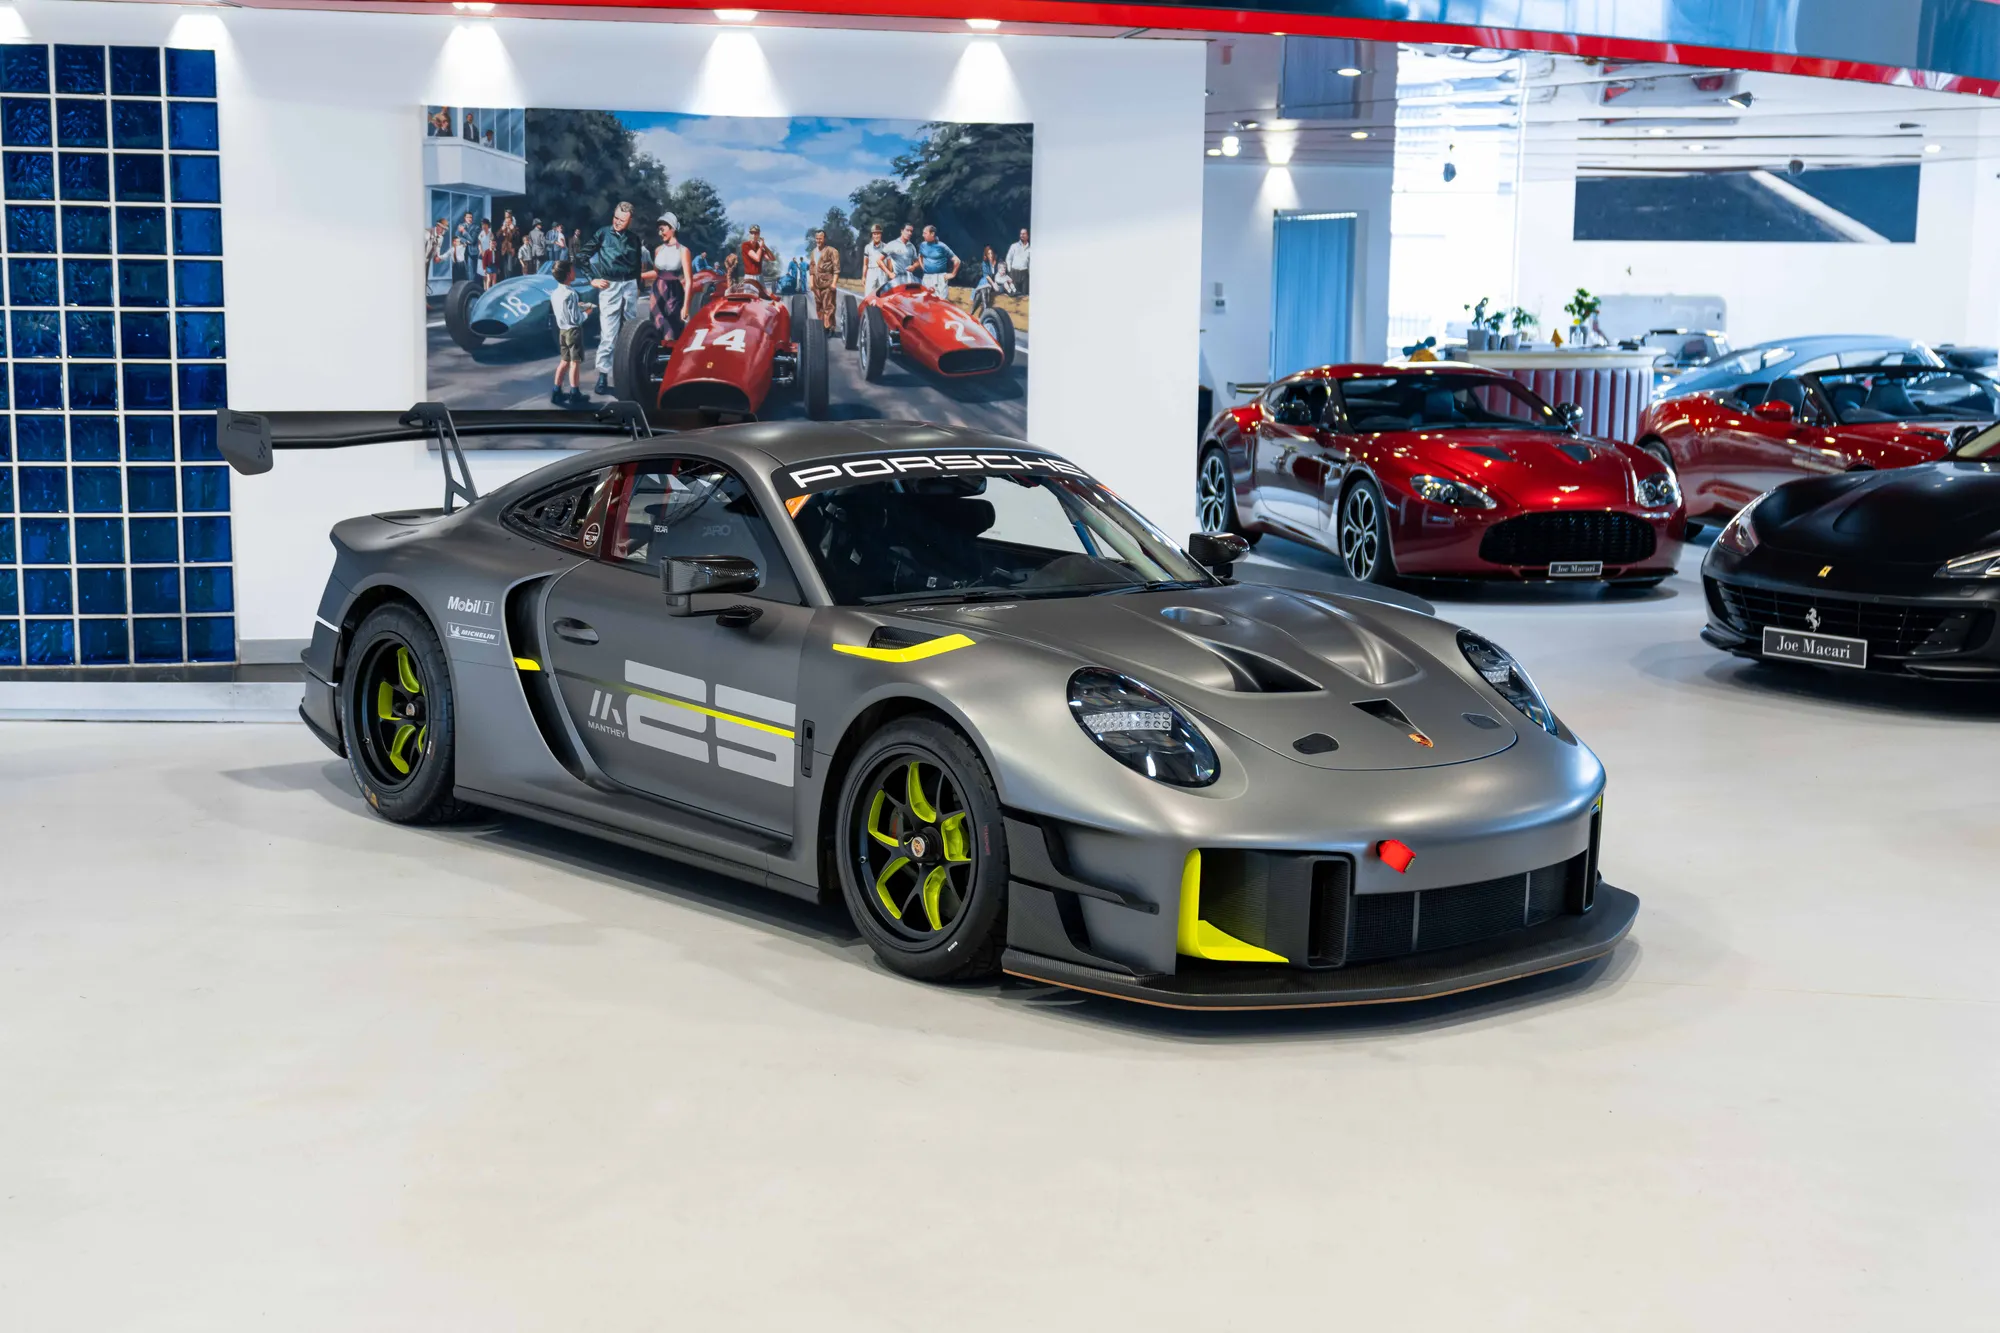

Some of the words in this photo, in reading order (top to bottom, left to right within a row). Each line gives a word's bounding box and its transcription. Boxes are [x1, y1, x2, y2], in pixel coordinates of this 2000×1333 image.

[500, 296, 531, 318] 18
[683, 328, 746, 353] 14
[944, 319, 976, 342] 2
[789, 454, 1089, 488] PORSCHE
[1556, 564, 1569, 573] Joe
[1570, 564, 1596, 573] Macari
[447, 595, 481, 614] Mobil
[460, 629, 496, 640] MICHELIN
[1776, 635, 1799, 652] Joe
[1802, 638, 1851, 659] Macari
[587, 720, 627, 739] MANTHEY
[624, 659, 797, 788] 25
